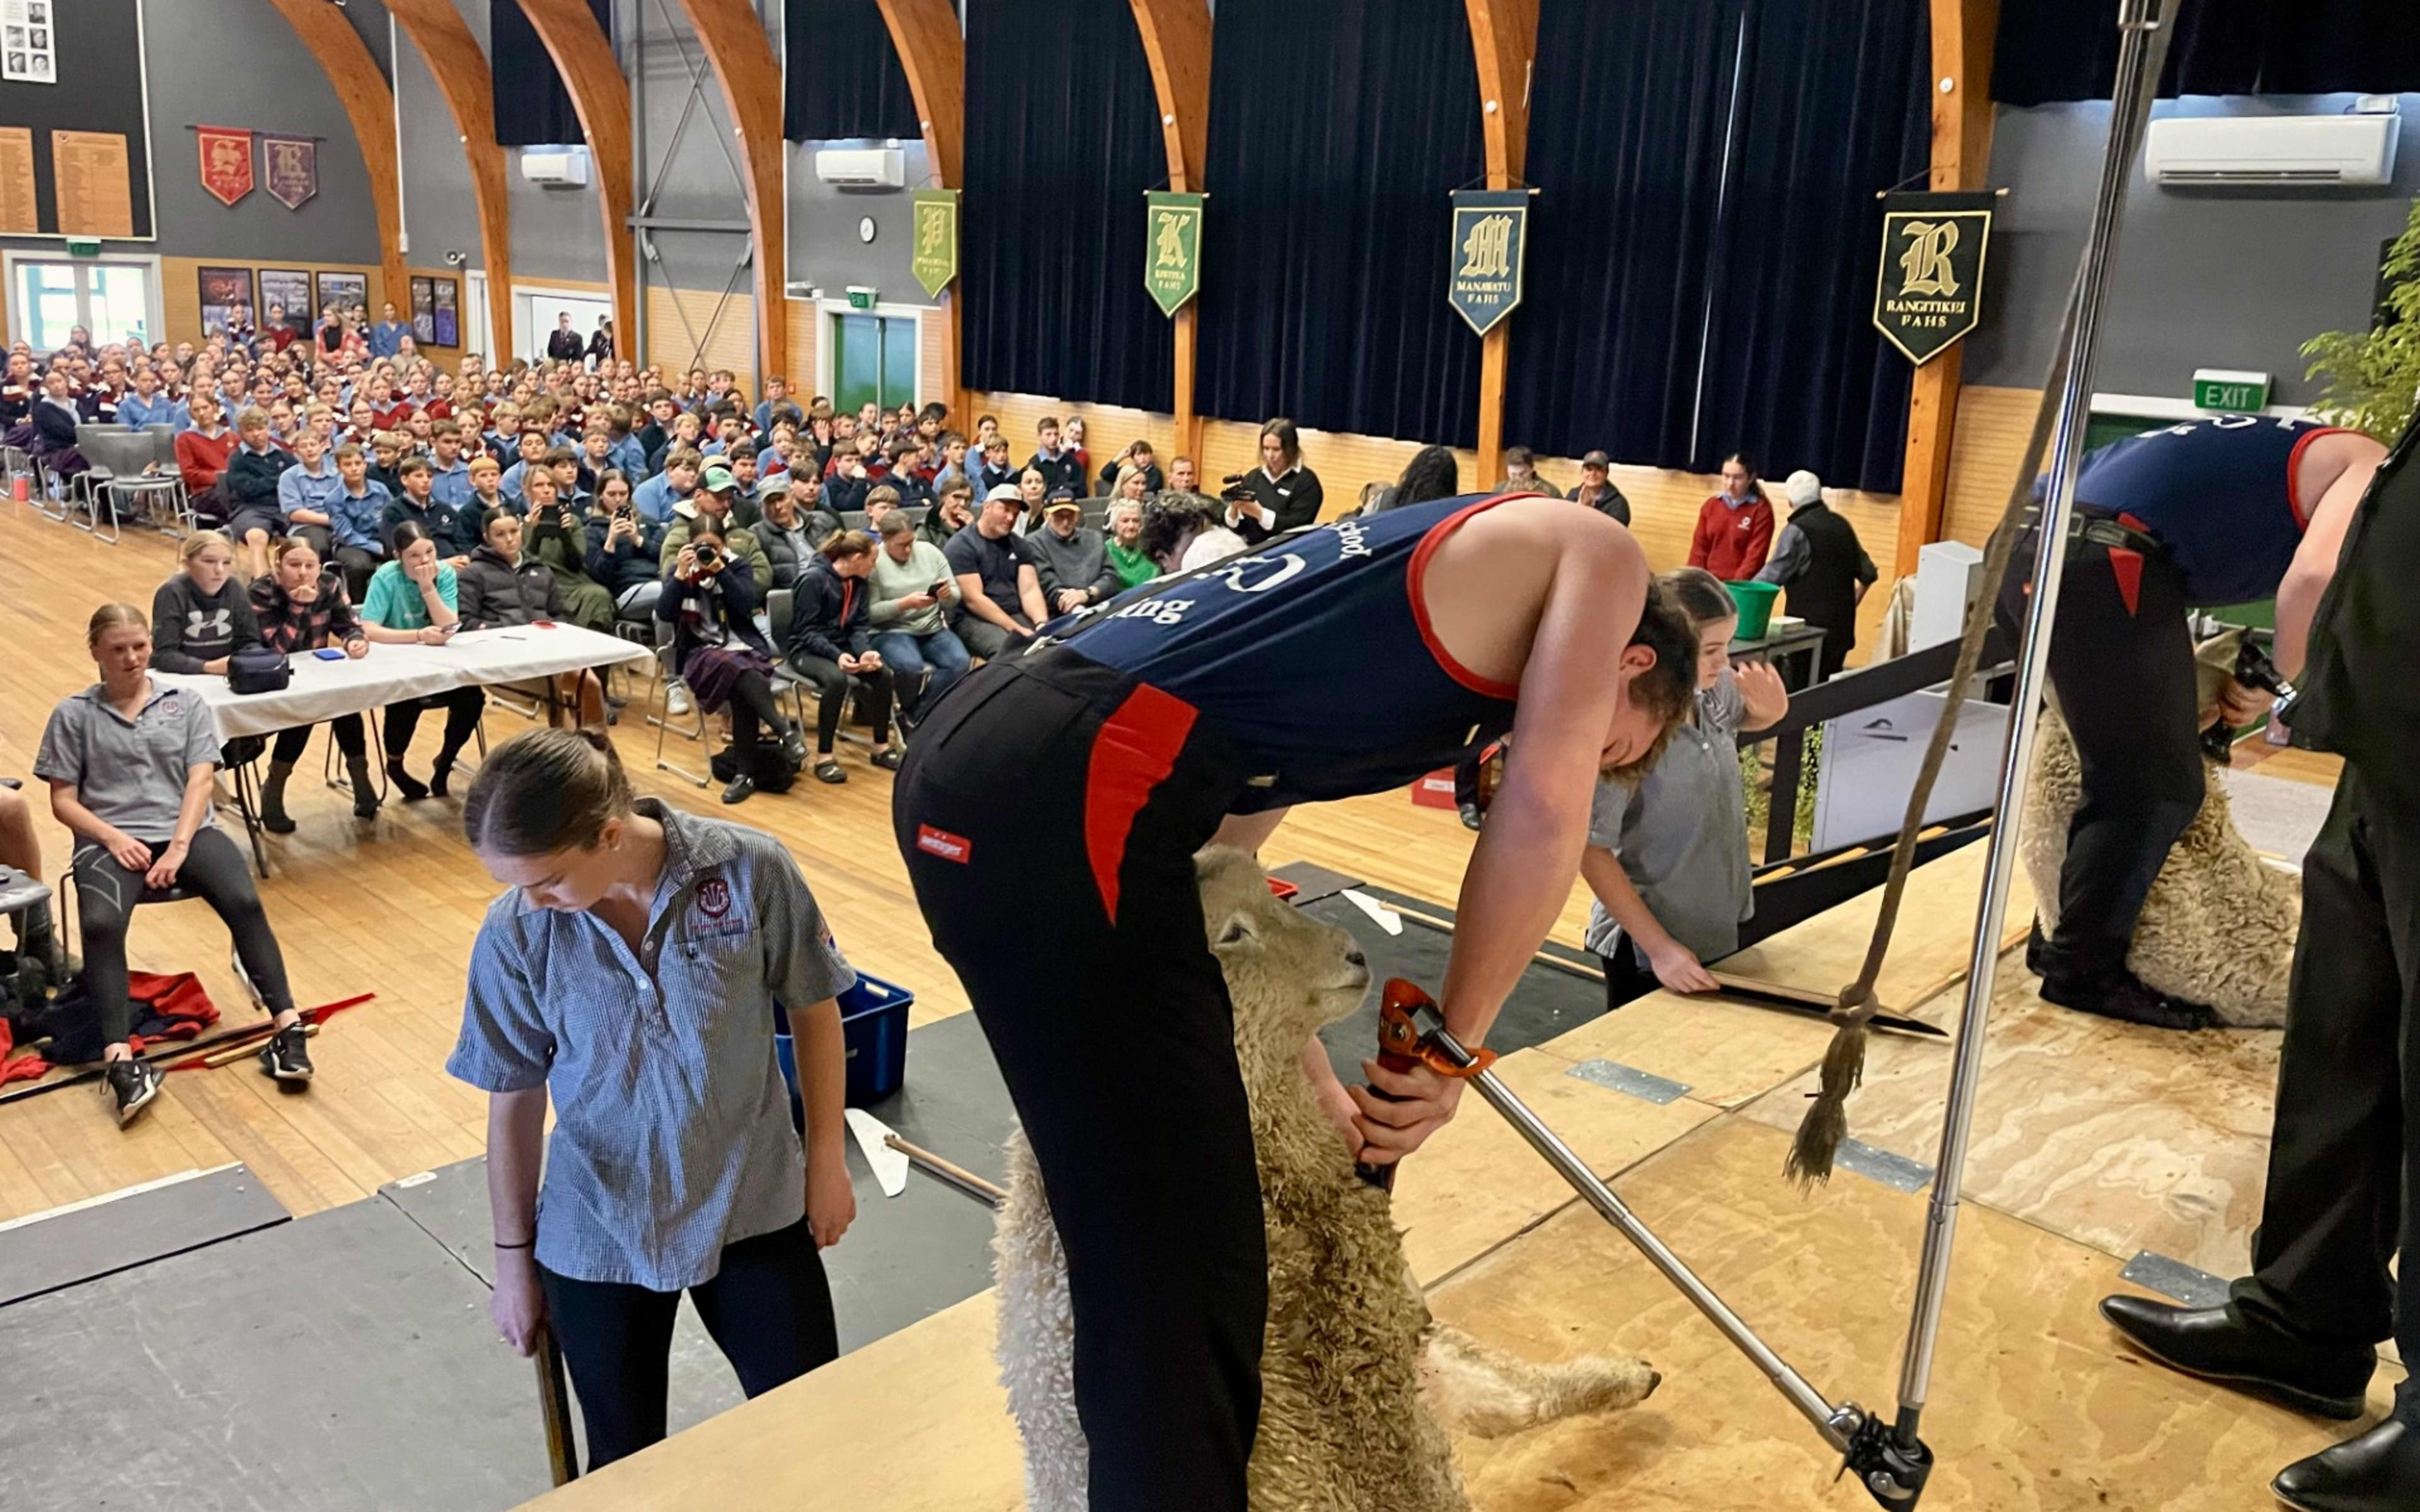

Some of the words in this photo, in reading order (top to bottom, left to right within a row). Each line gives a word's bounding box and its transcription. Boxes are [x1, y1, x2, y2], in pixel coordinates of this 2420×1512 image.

[1156, 211, 1190, 268] K
[1459, 214, 1513, 278] M
[1899, 220, 1961, 297] R
[1456, 281, 1511, 292] MANAWATU
[1467, 292, 1499, 304] FAHS
[1886, 299, 1966, 314] RANGITIKEI
[1901, 314, 1947, 327] FAHS
[2205, 385, 2250, 408] EXIT
